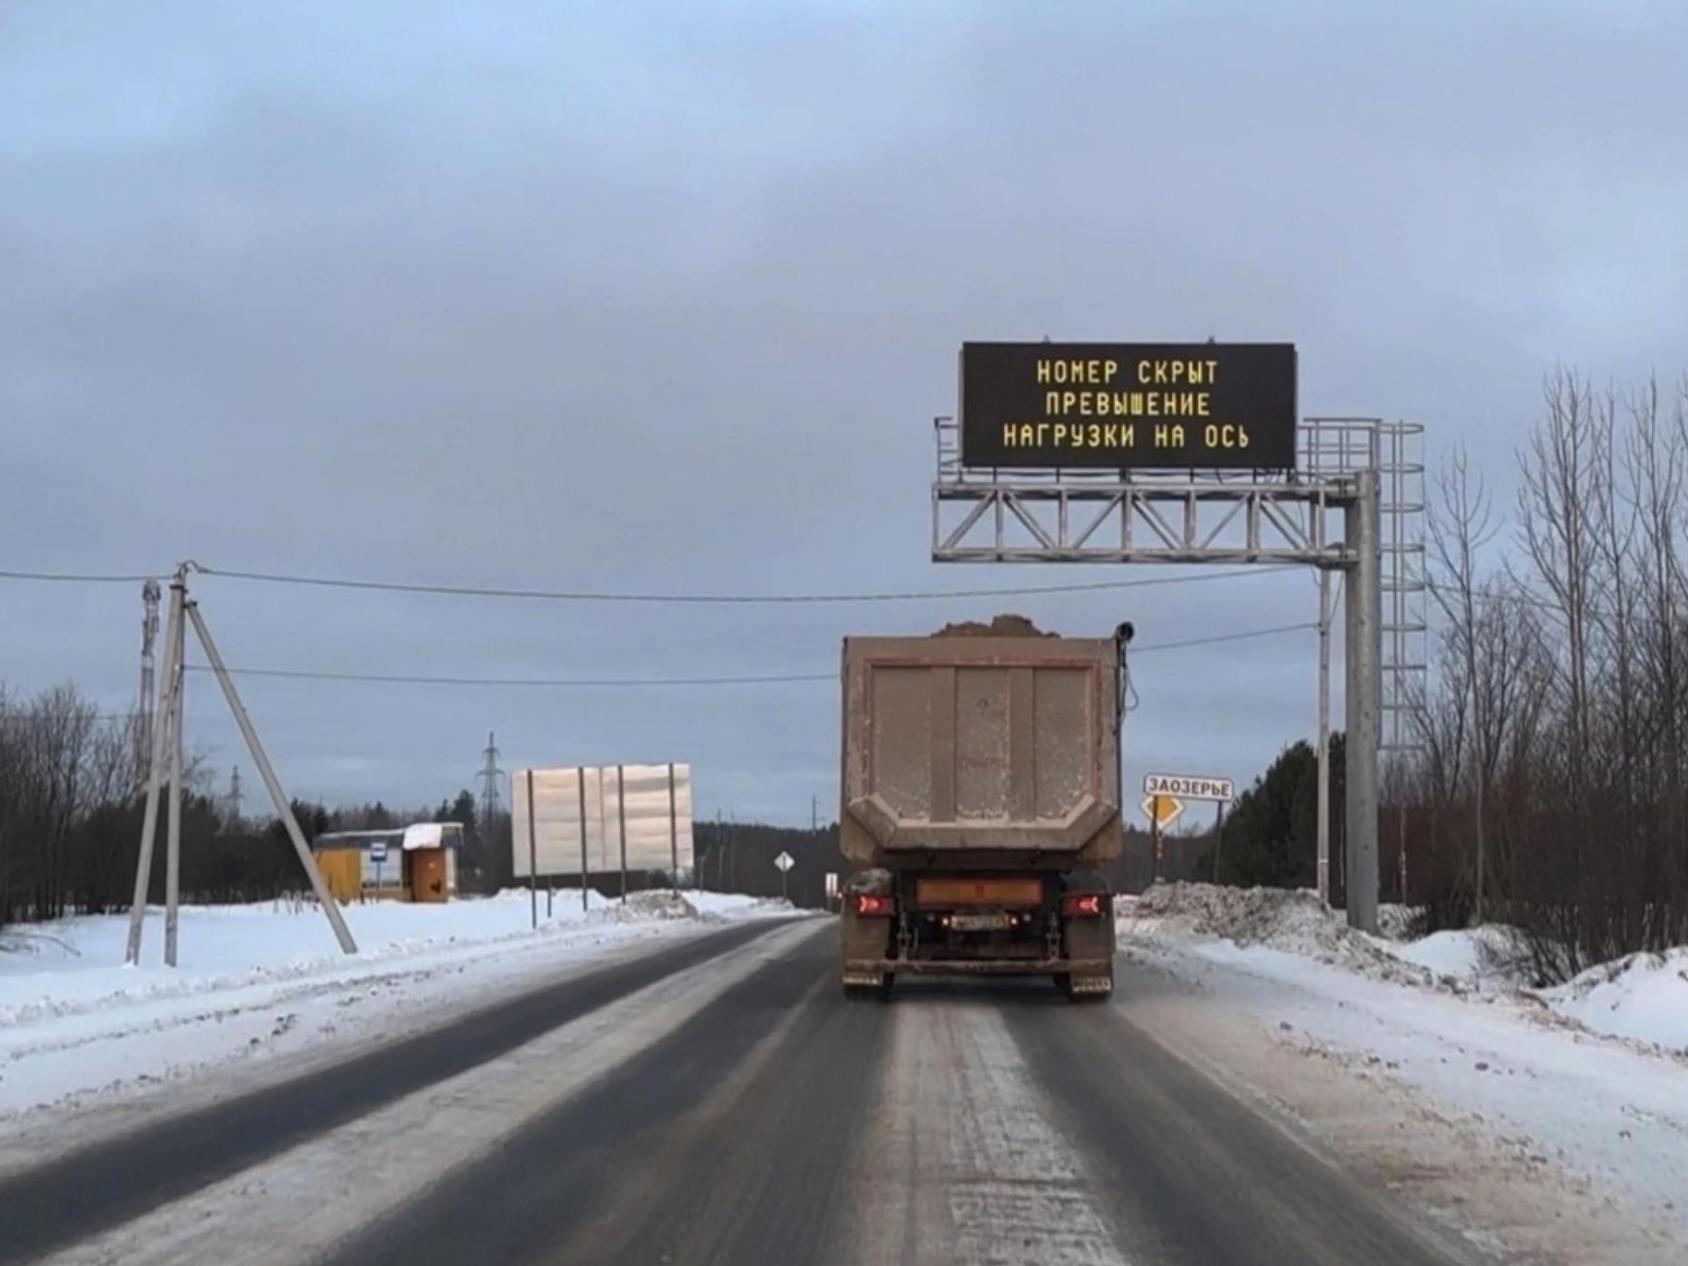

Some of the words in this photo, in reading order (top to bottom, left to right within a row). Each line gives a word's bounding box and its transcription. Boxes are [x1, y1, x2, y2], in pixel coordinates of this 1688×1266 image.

[1037, 360, 1118, 383] НОМЕР
[1137, 360, 1218, 384] СКРЫТ
[1046, 392, 1210, 415] ПРЕВЫШЕНИЕ
[1003, 424, 1134, 447] НАГРУЗКИ
[1154, 424, 1184, 447] НА
[1205, 425, 1249, 448] ОСЬ
[1149, 778, 1230, 796] ЗАОЗЕРЬЕ
